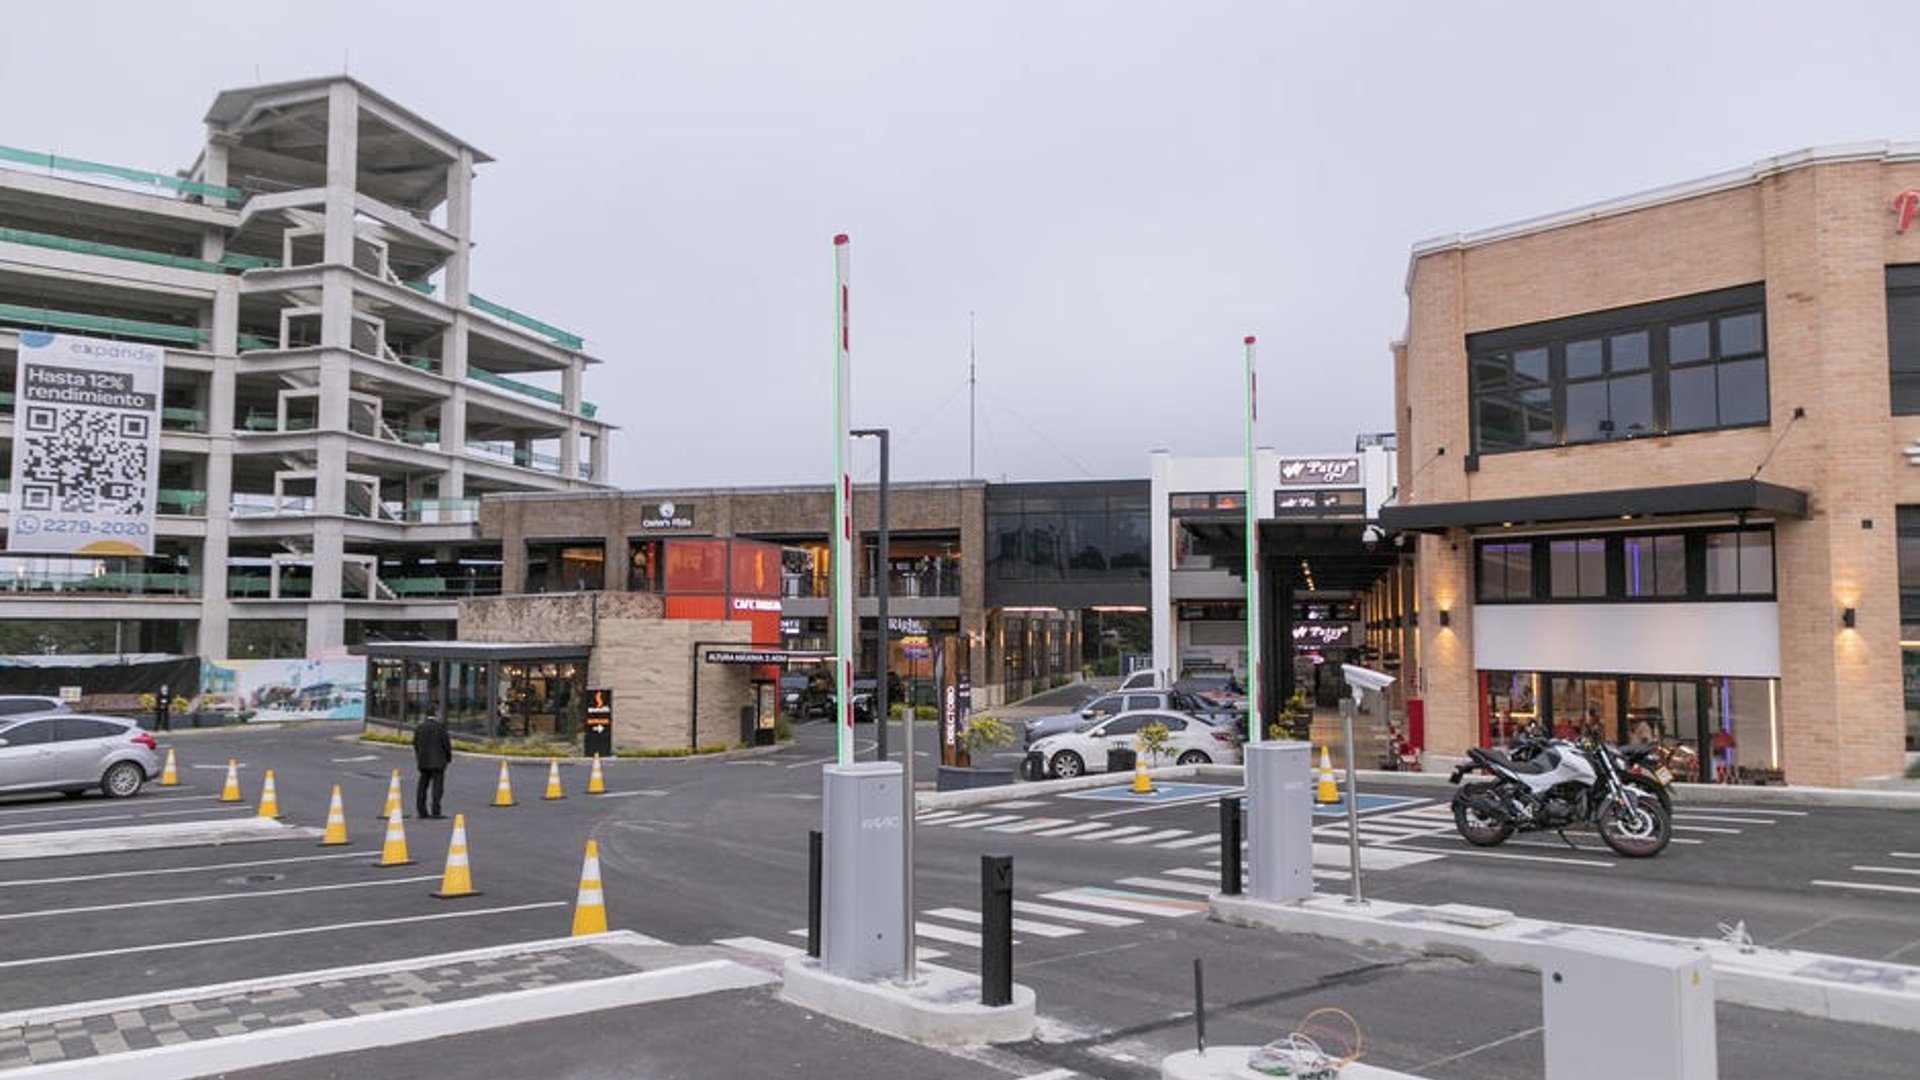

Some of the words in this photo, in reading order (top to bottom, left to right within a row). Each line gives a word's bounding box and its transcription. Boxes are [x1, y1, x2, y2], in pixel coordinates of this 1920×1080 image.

[70, 344, 156, 360] expande
[28, 367, 86, 386] Hasta
[89, 373, 125, 391] 12%
[27, 386, 146, 407] rendimiento
[42, 519, 149, 536] 2279-2020
